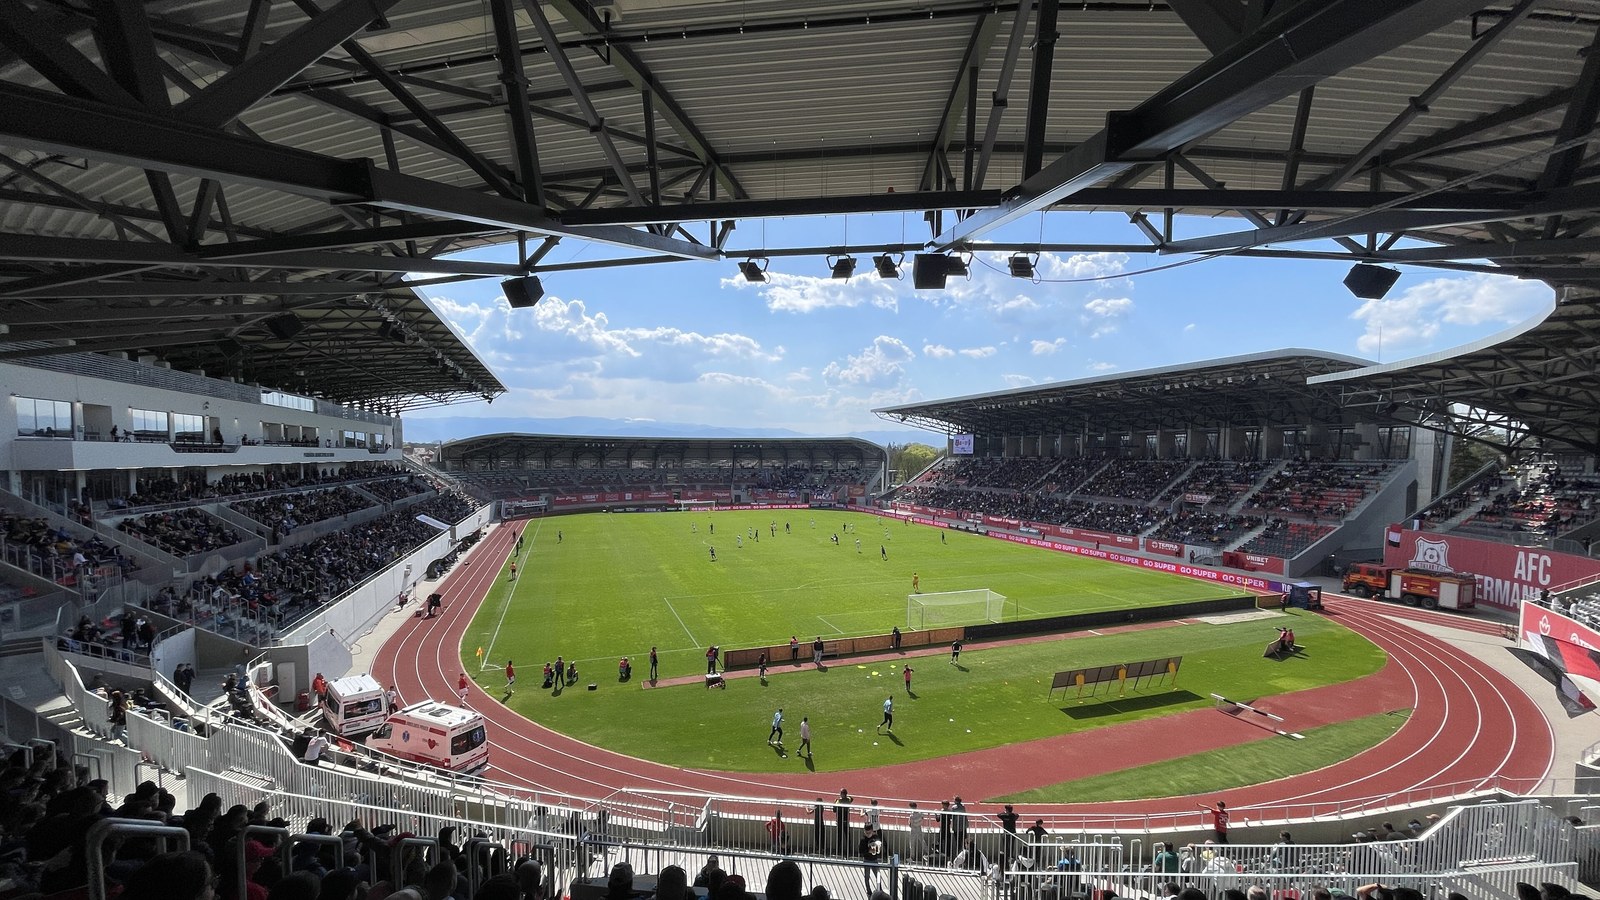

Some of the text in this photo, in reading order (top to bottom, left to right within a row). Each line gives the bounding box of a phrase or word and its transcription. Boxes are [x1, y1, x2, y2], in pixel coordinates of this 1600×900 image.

[1062, 544, 1078, 553] SUPER
[1089, 550, 1107, 558] SUPER
[1119, 555, 1139, 564] SUPER
[1246, 555, 1269, 563] UNIBET
[1154, 562, 1176, 571] SUPER
[1514, 551, 1552, 586] AFC
[1180, 566, 1217, 579] GO SUPER
[1222, 574, 1265, 588] GO SUPER
